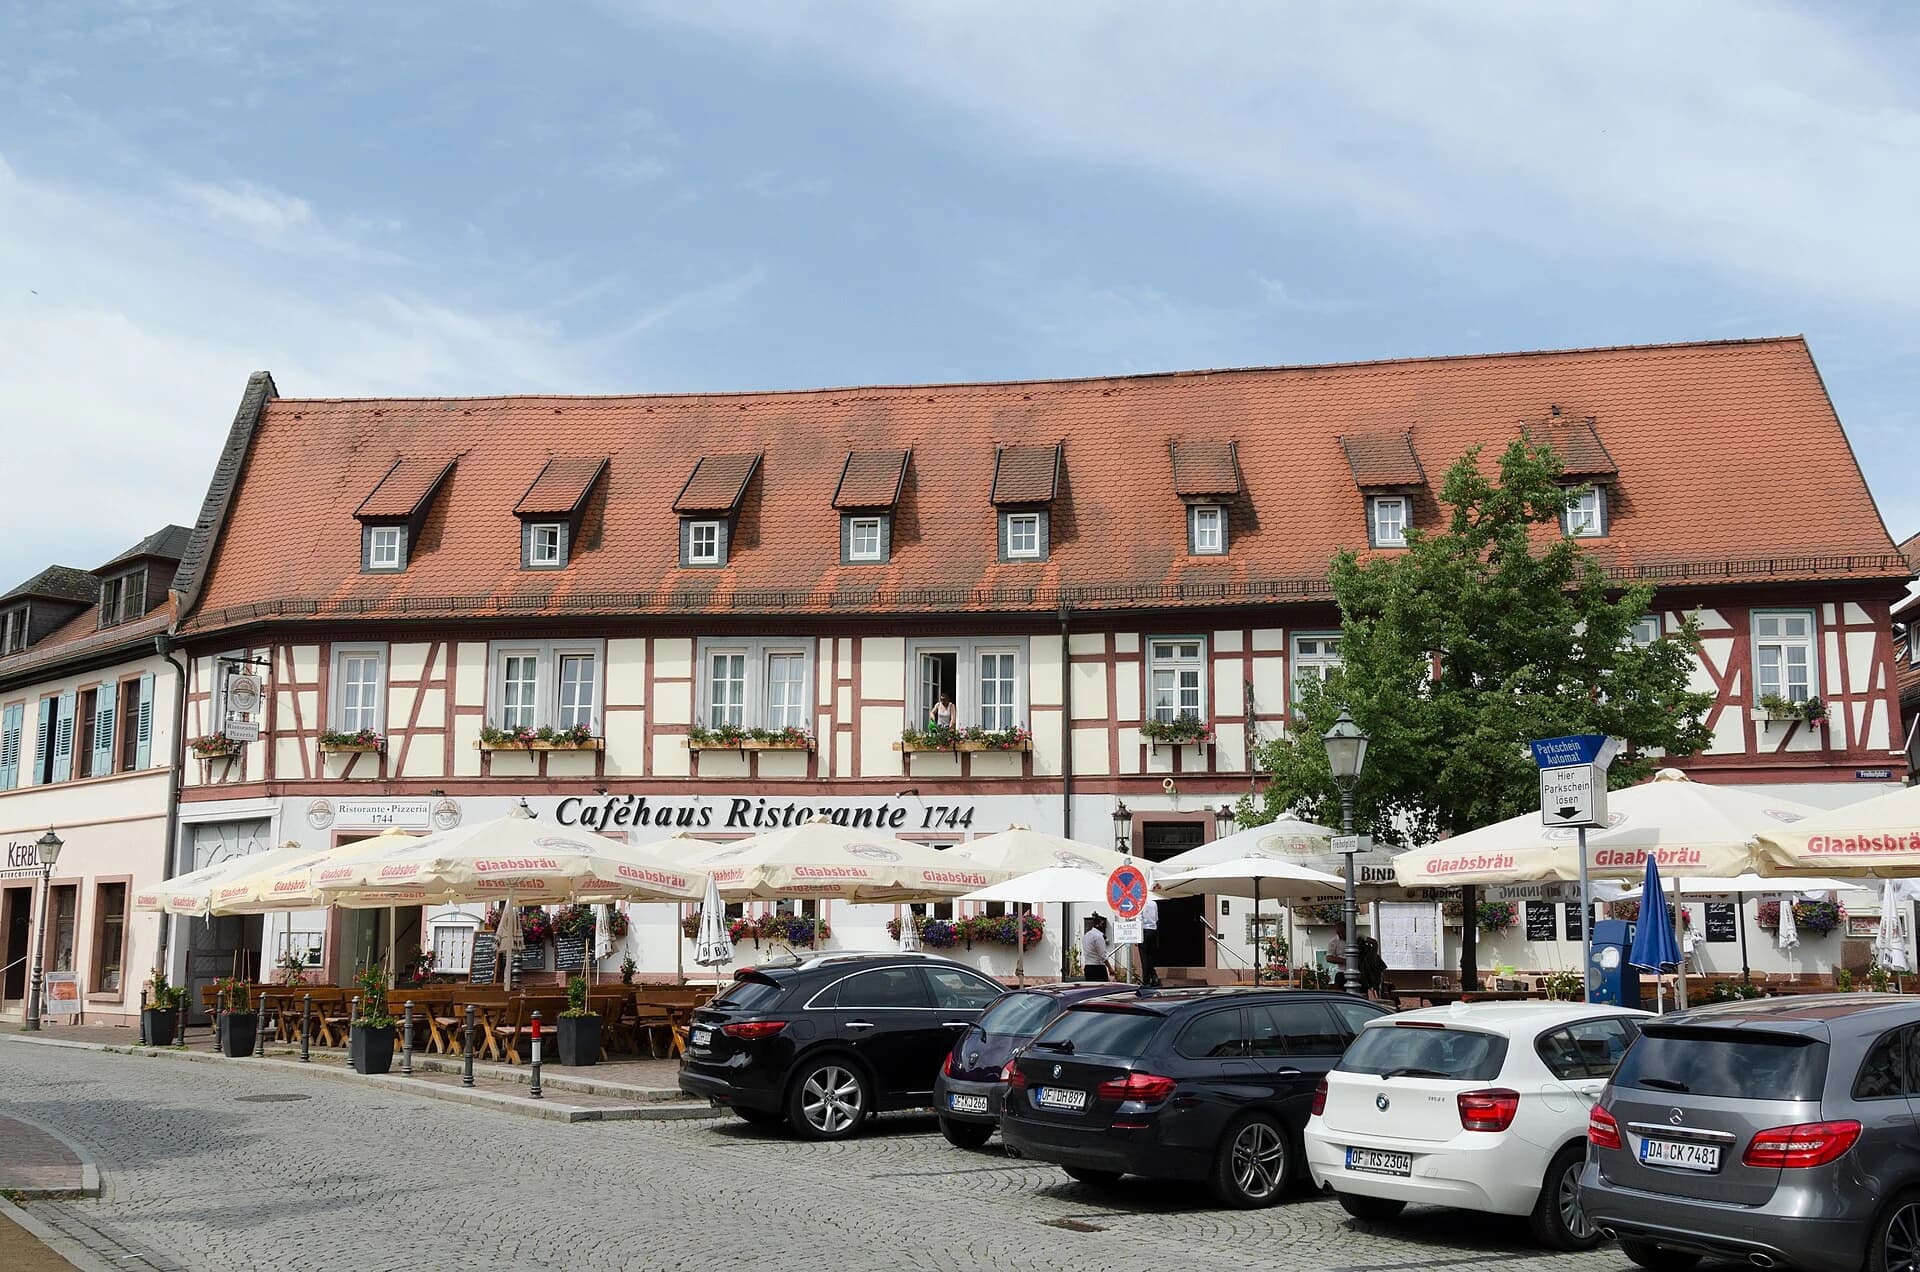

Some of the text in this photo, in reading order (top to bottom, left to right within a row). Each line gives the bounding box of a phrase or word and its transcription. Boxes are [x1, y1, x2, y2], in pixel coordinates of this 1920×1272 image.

[1536, 740, 1581, 754] Parkschein
[1547, 752, 1581, 765] Automat
[1557, 771, 1575, 781] Hier
[1544, 782, 1590, 794] Parkschein
[1556, 796, 1579, 805] lösen
[339, 804, 386, 813] Ristorante
[391, 804, 428, 813] Pizzeria
[555, 794, 975, 831] Caféhaus Ristorante 1744
[371, 814, 393, 824] 1744
[1595, 848, 1700, 866] Glaabbräu
[475, 857, 558, 872] Glaabsbräu
[1426, 855, 1514, 874] Glaabsbräu
[618, 864, 686, 889] Glaabsbräu
[795, 866, 868, 879] Glaabsbräu
[922, 870, 987, 885] Glaabsbräu
[1042, 1088, 1053, 1100] OF
[1352, 1150, 1409, 1170] OF RS 2304
[1648, 1141, 1716, 1165] DA CK 7481
